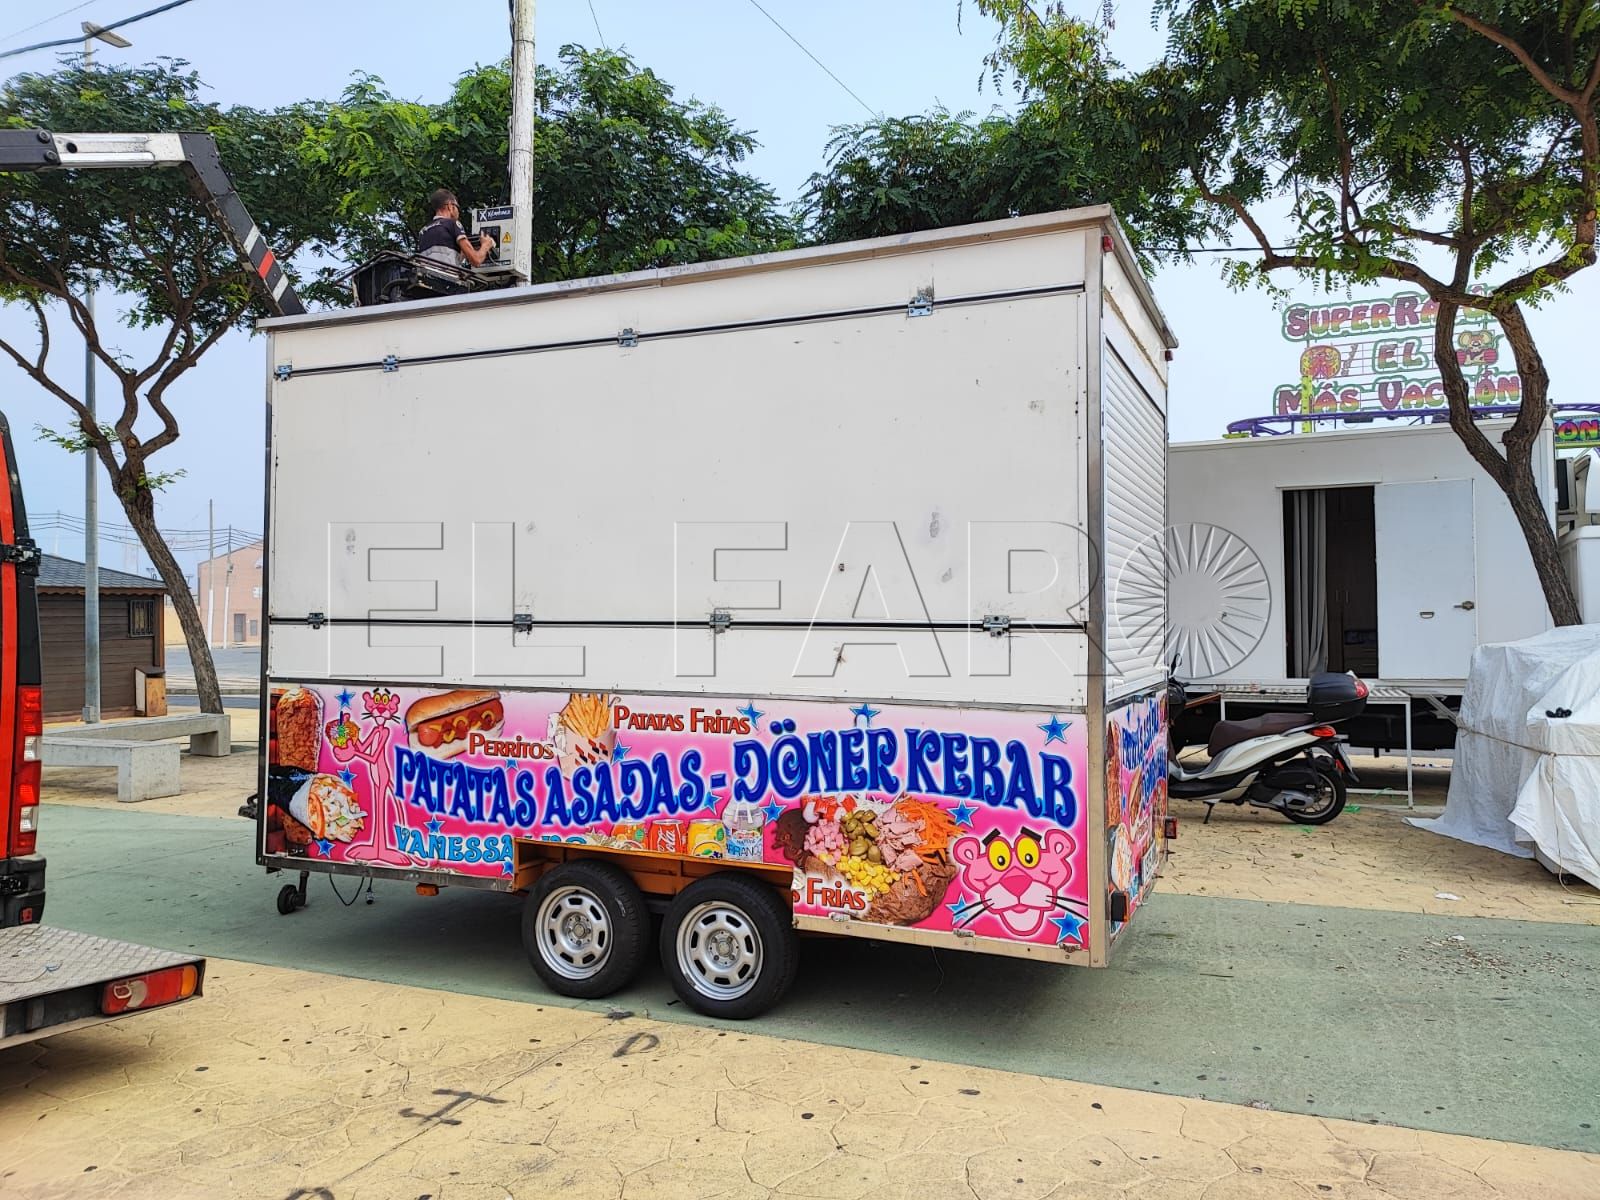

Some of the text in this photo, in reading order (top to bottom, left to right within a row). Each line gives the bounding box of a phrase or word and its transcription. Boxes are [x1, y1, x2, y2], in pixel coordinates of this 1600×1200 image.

[1377, 342, 1423, 369] EL
[394, 746, 537, 828] PATATAS
[541, 749, 706, 827] ASADAS
[733, 718, 899, 802] DÖNER
[904, 728, 1076, 829] KEBAB
[394, 824, 514, 863] VANESSA
